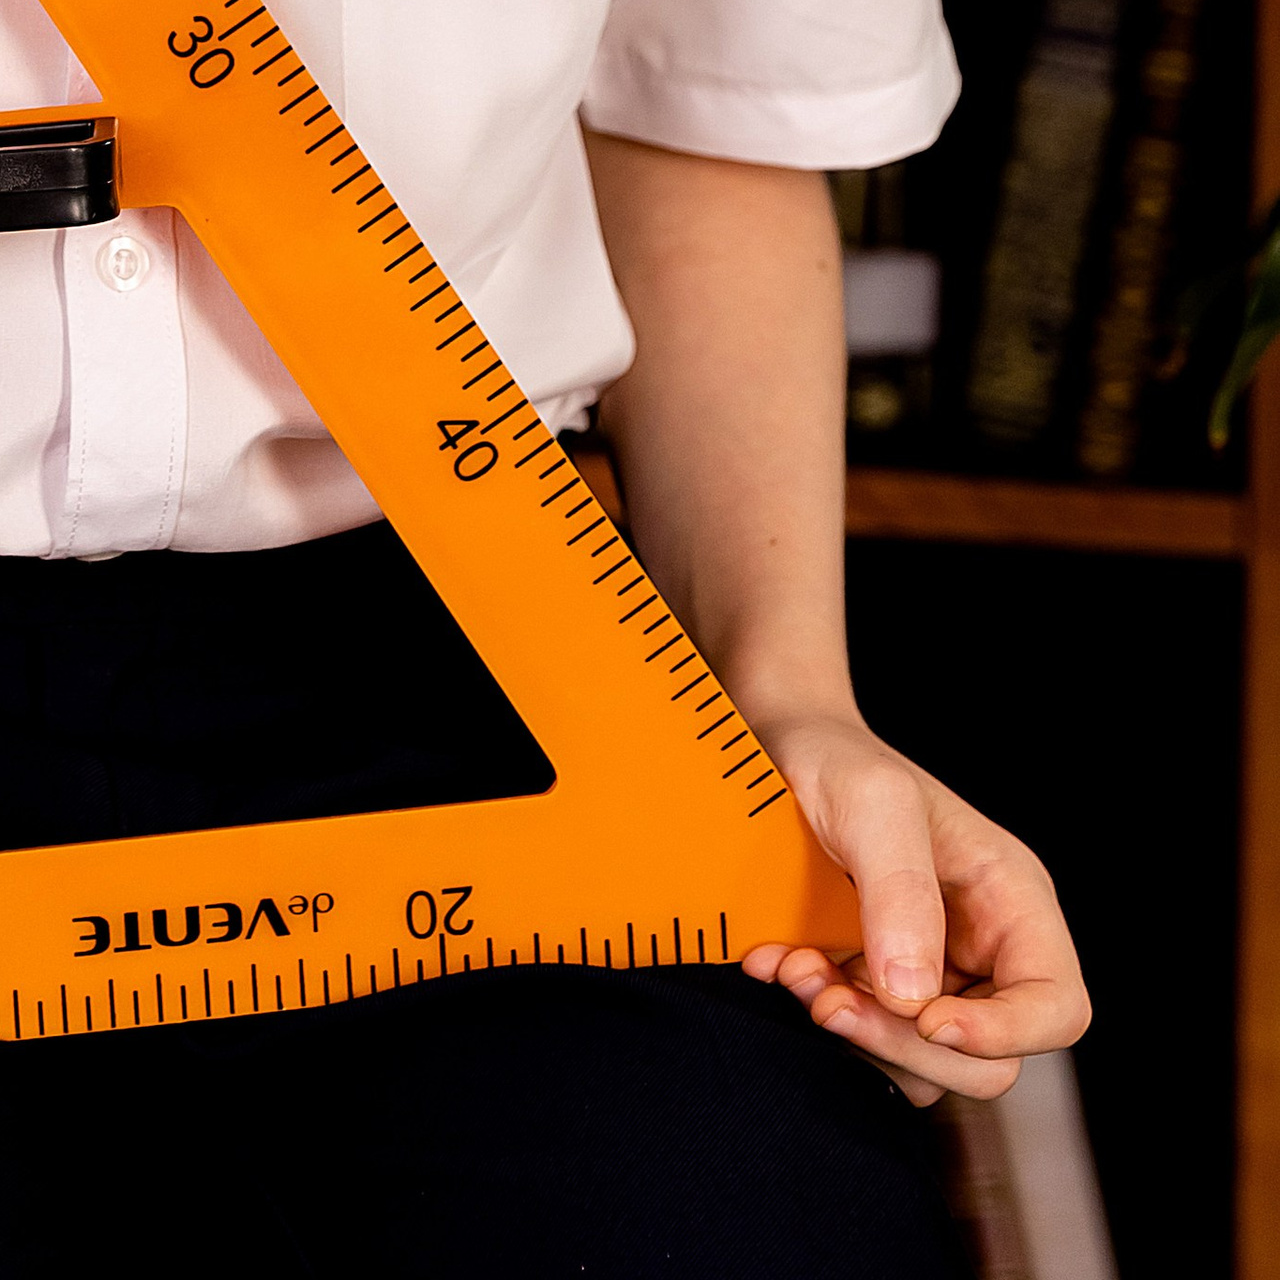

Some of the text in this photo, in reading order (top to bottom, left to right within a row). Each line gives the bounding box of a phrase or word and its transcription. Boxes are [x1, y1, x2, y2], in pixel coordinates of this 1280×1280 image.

[167, 15, 235, 89] 30
[436, 419, 499, 482] 40
[71, 892, 335, 958] deVENTE
[405, 885, 474, 940] 20
